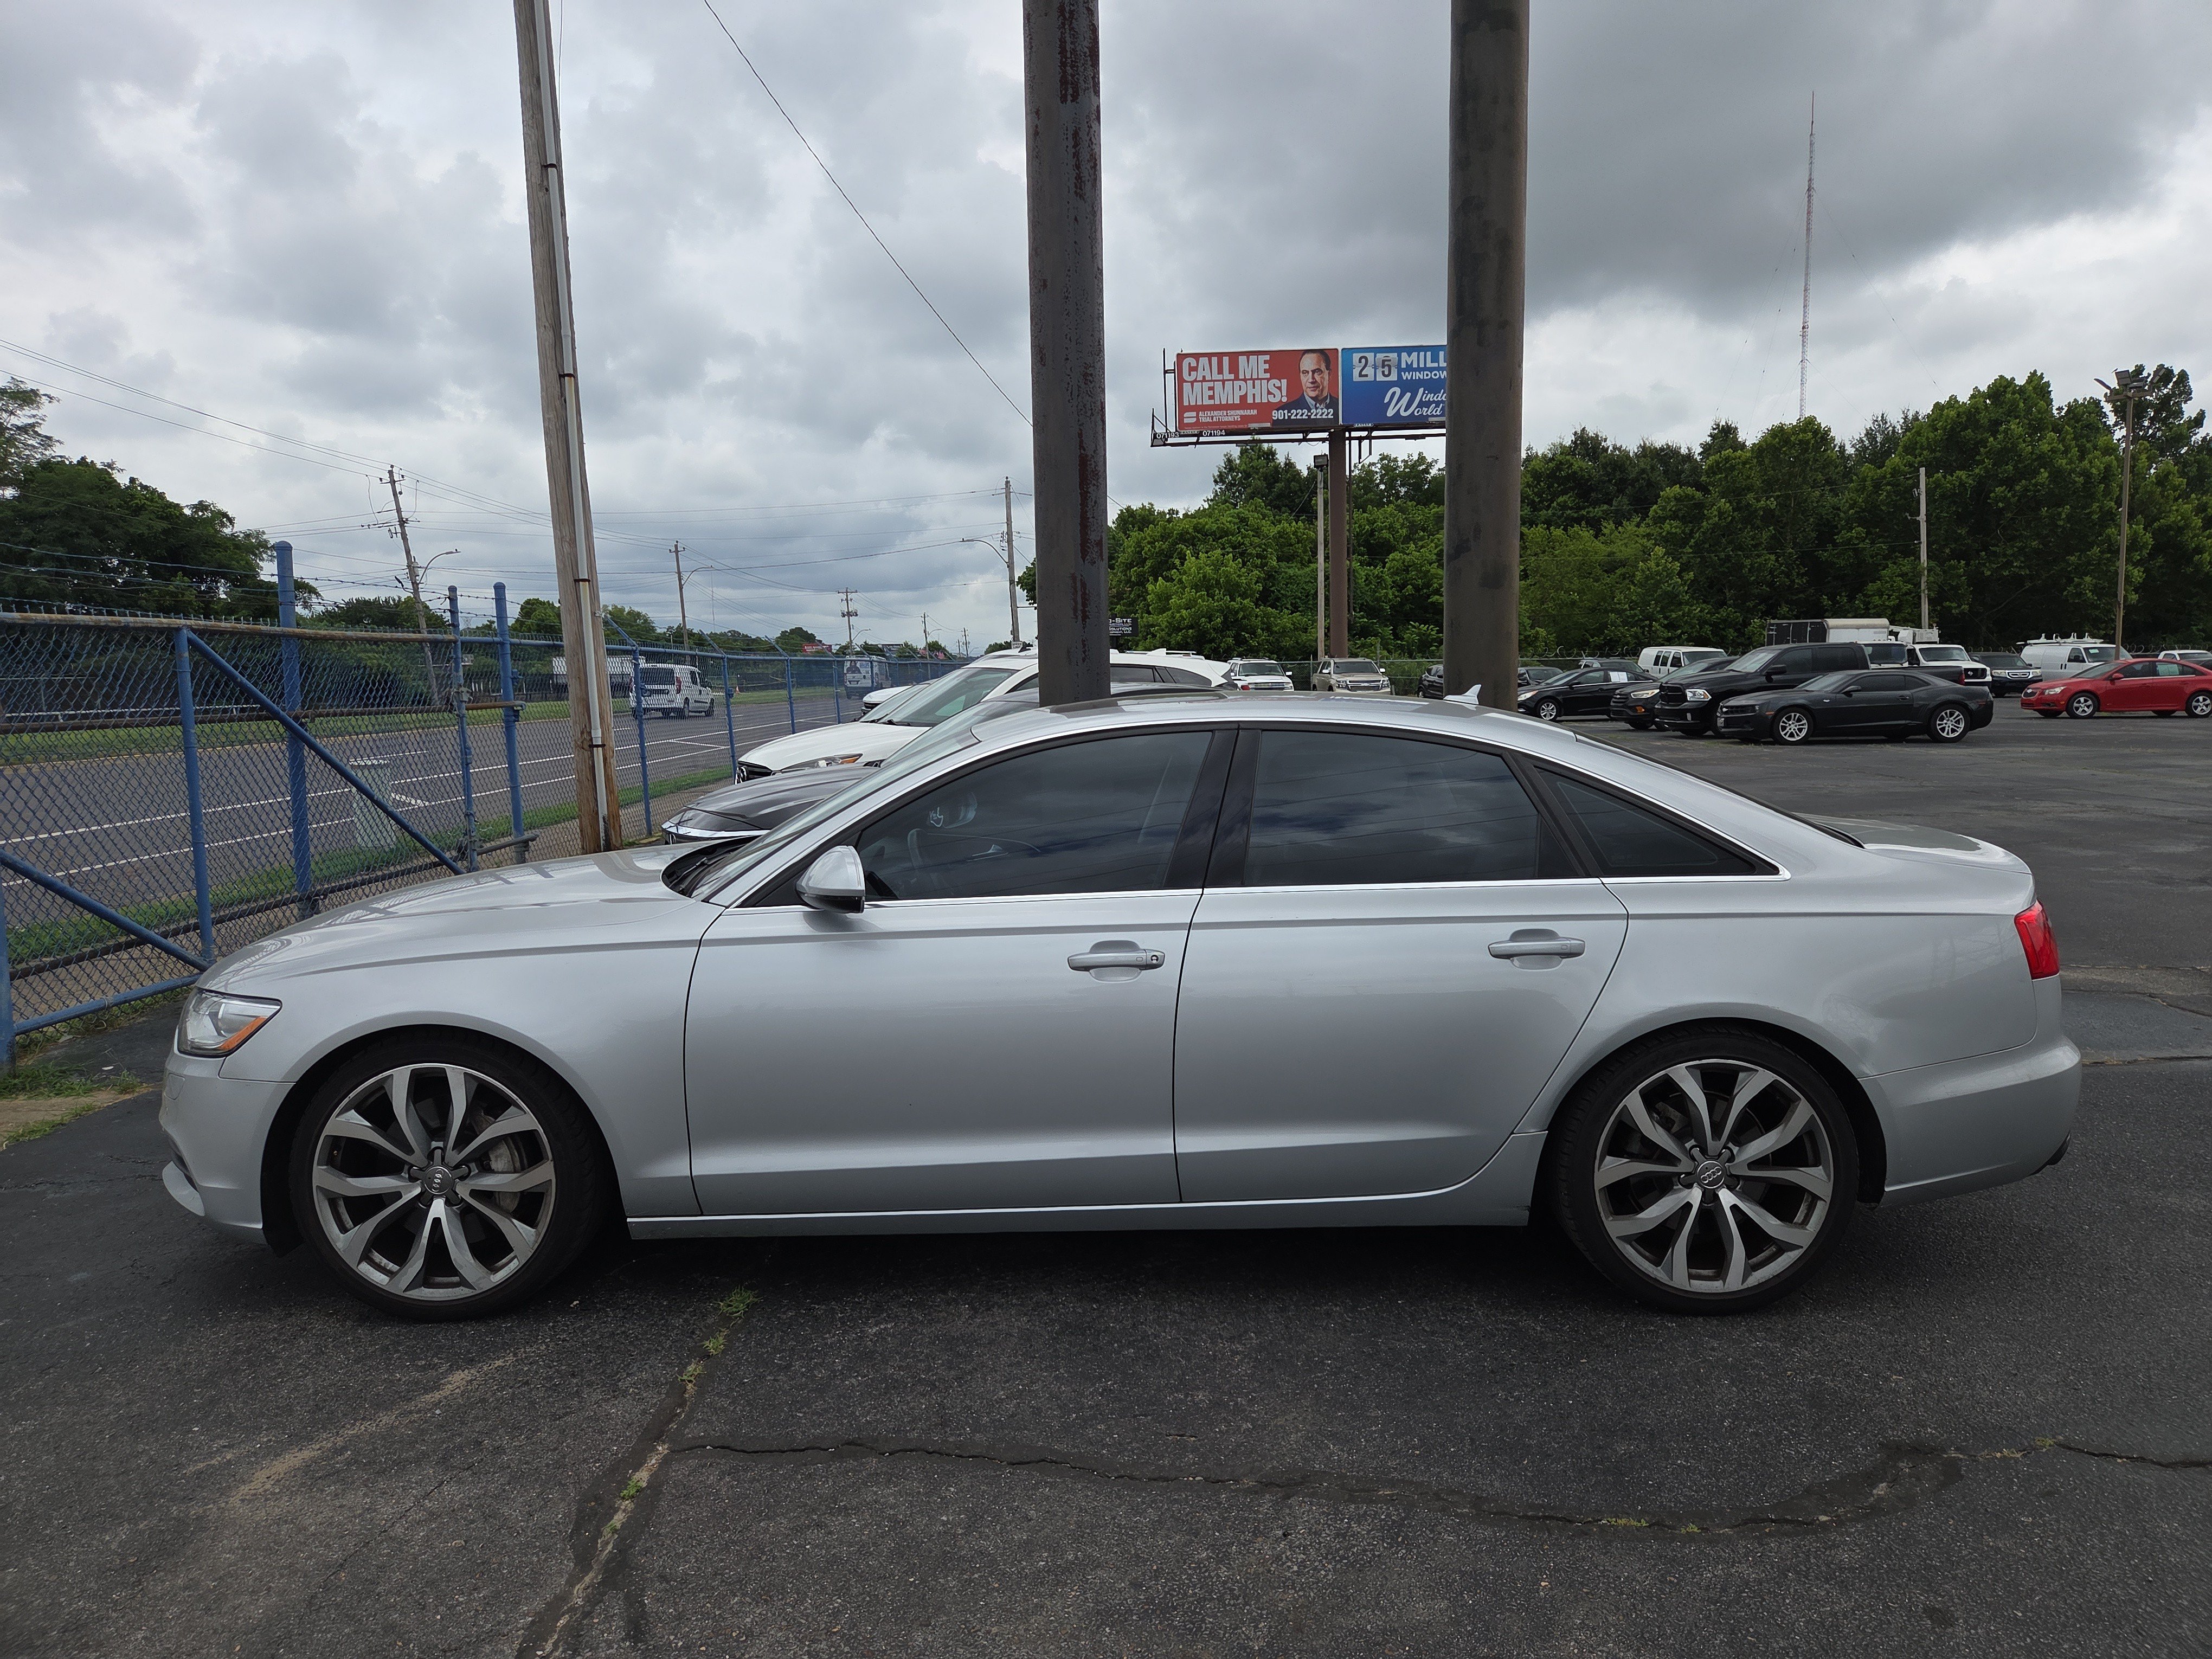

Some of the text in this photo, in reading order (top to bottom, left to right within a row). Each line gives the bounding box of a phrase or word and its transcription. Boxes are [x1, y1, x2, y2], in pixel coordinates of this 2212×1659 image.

[1182, 355, 1270, 381] CALL ME
[1183, 379, 1288, 406] MEMPHIS!
[1272, 409, 1334, 420] 901-222-2222
